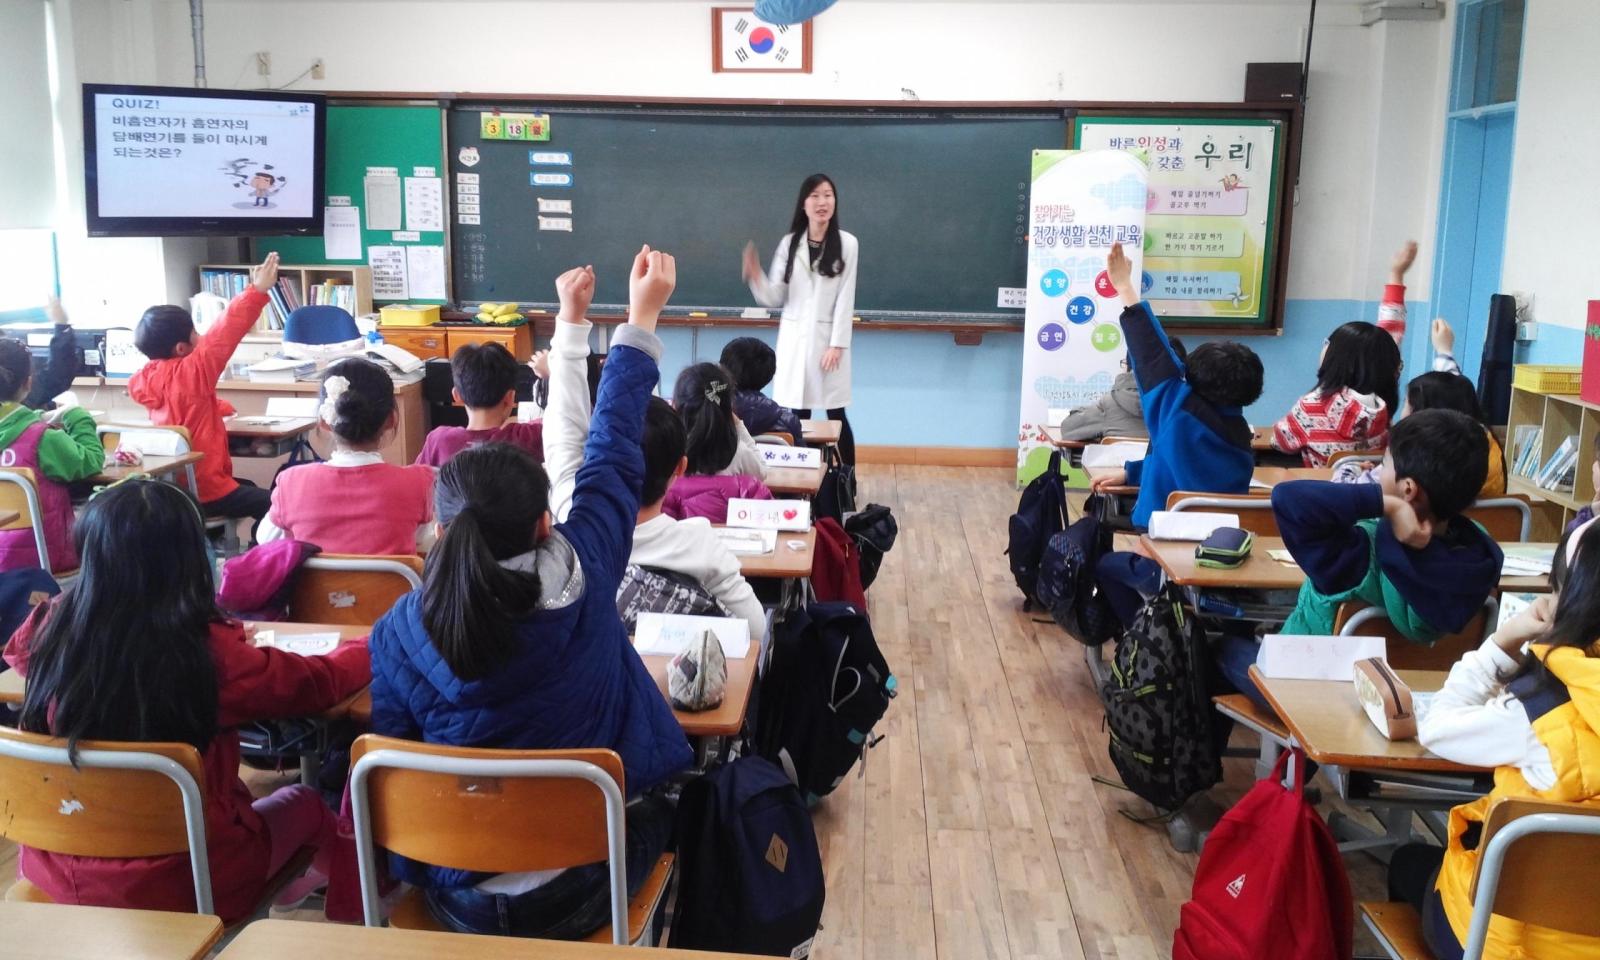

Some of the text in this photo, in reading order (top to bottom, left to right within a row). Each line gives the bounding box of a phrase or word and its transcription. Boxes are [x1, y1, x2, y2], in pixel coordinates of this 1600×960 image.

[112, 98, 160, 110] QUIZ!
[112, 115, 249, 130] 비흡연자가 흡연자의
[490, 124, 497, 134] 3
[509, 125, 522, 135] 18
[112, 131, 187, 144] 담배연기를
[226, 135, 268, 146] 마시게
[113, 147, 183, 159] 되는것은?
[1194, 141, 1253, 169] 우리
[1158, 156, 1184, 169] 갖춘
[1032, 224, 1141, 247] 건강 생활 실천 교육
[1069, 304, 1092, 316] 건강
[1040, 331, 1064, 342] 금연
